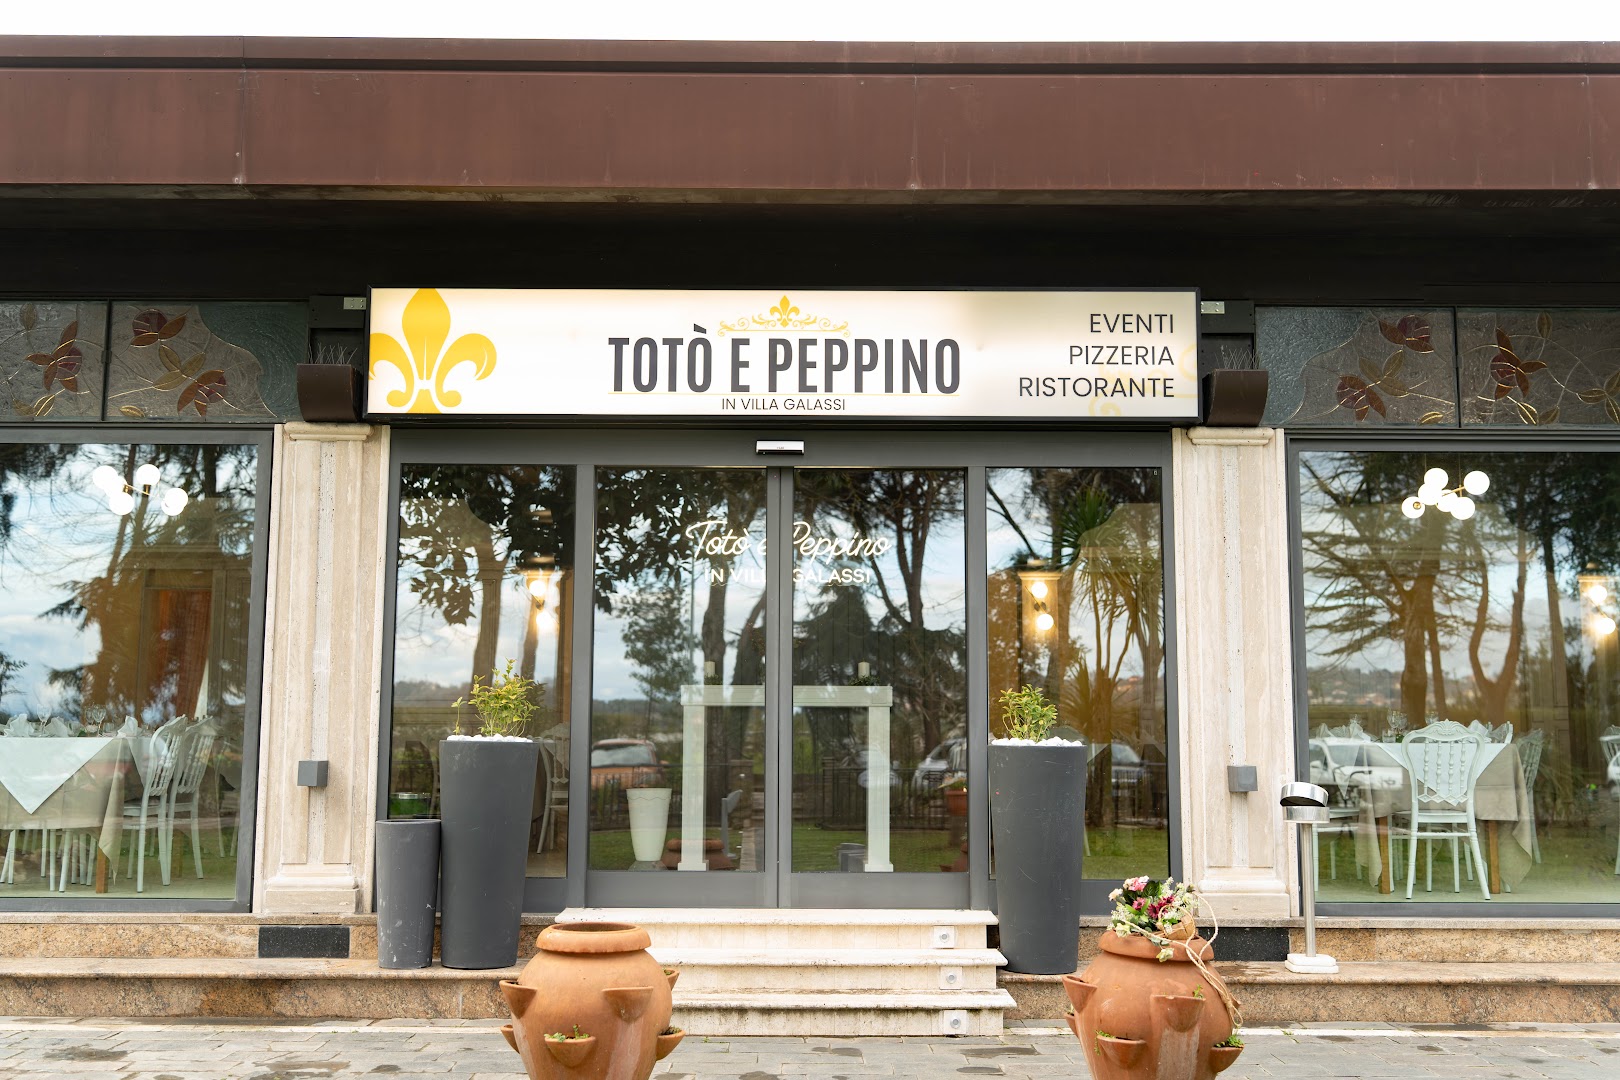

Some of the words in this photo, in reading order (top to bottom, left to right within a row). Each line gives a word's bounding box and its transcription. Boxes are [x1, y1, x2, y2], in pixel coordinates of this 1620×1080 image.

[1090, 313, 1174, 334] EVENTI
[608, 323, 712, 393] TOTÒ
[730, 338, 750, 393] E
[768, 338, 960, 394] PEPPINO
[1069, 345, 1175, 365] PIZZERIA
[1019, 377, 1175, 398] RISTORANTE
[722, 398, 736, 410] IN
[740, 398, 779, 410] VILLA
[783, 398, 845, 411] GALASSI
[686, 521, 752, 558] Totò
[793, 521, 892, 565] Peppino
[705, 568, 724, 583] IN
[729, 568, 767, 583] VILL
[793, 568, 870, 584] GALASSI
